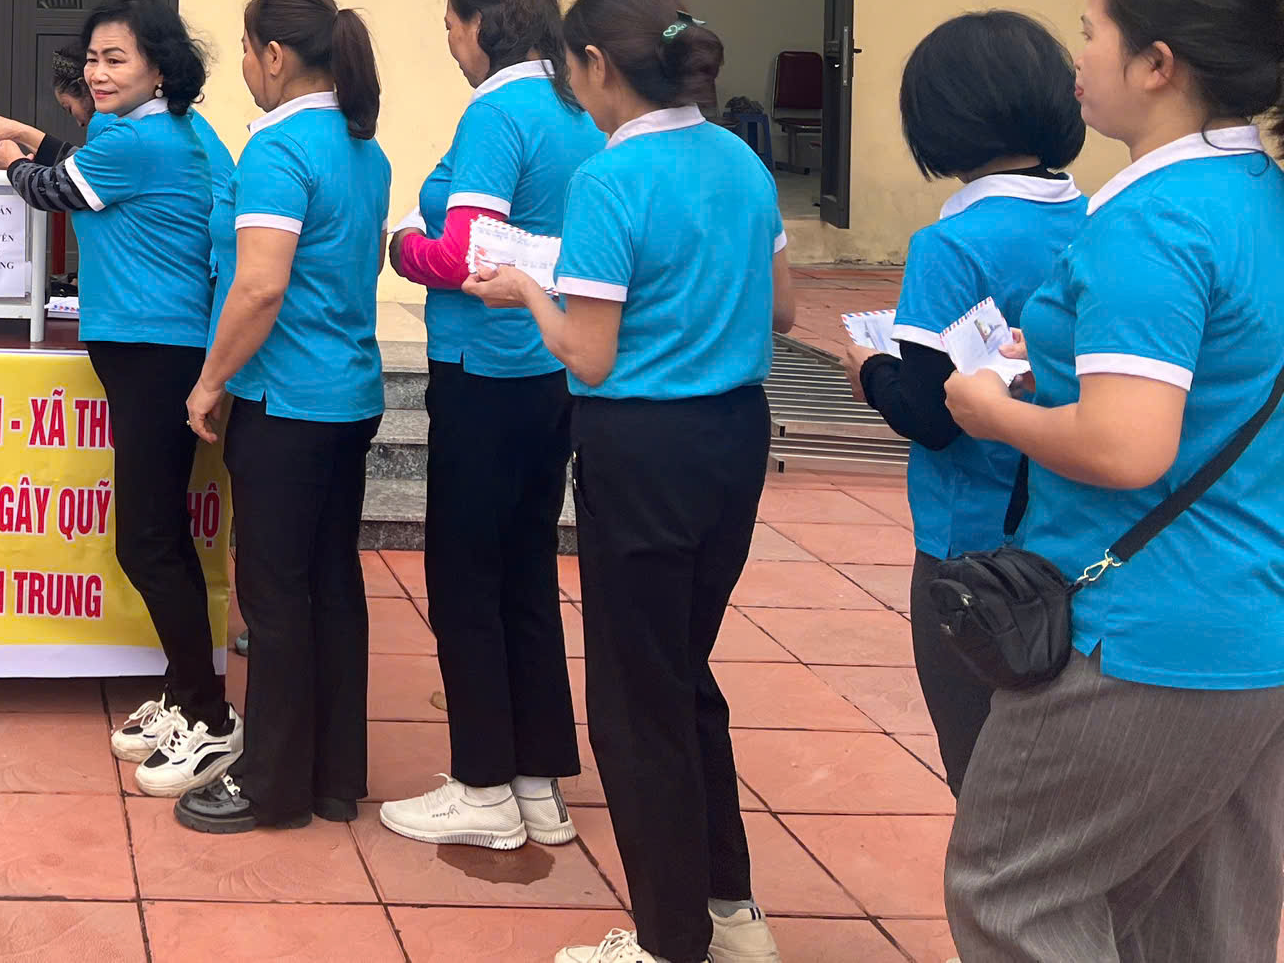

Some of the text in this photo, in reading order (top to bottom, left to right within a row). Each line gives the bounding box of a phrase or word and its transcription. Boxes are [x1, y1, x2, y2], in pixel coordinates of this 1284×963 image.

[10, 419, 21, 432] -
[29, 389, 67, 448] XÃ
[75, 399, 115, 449] TH
[58, 479, 112, 541] QUỸ
[187, 482, 221, 548] HỘ
[13, 571, 103, 620] TRUNG
